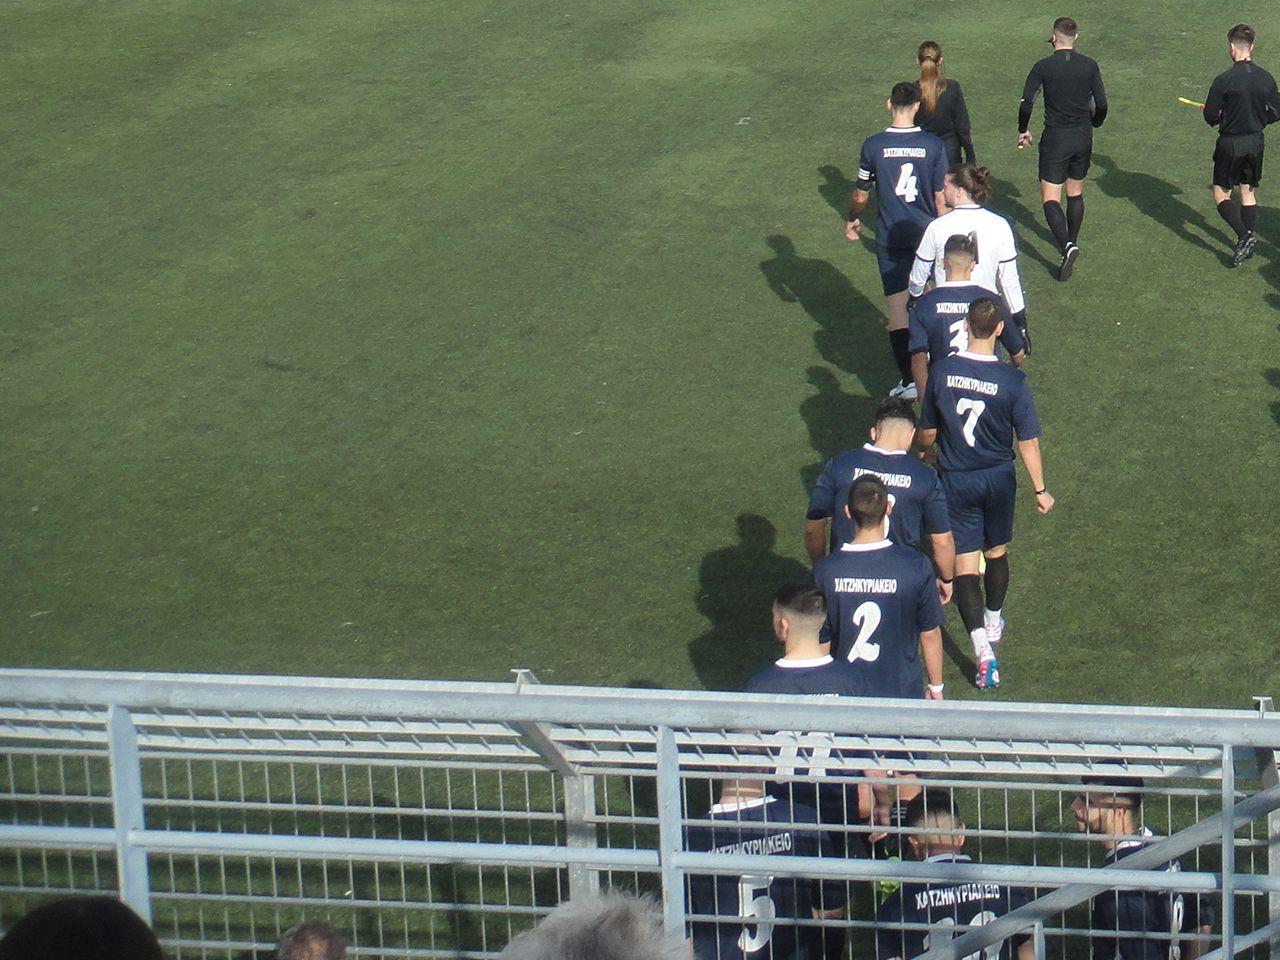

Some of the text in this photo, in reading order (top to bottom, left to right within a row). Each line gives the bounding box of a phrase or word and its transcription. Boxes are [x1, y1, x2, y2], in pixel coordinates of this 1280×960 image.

[895, 162, 918, 203] 4
[956, 397, 986, 447] 7
[847, 601, 882, 663] 2
[738, 874, 776, 953] 5
